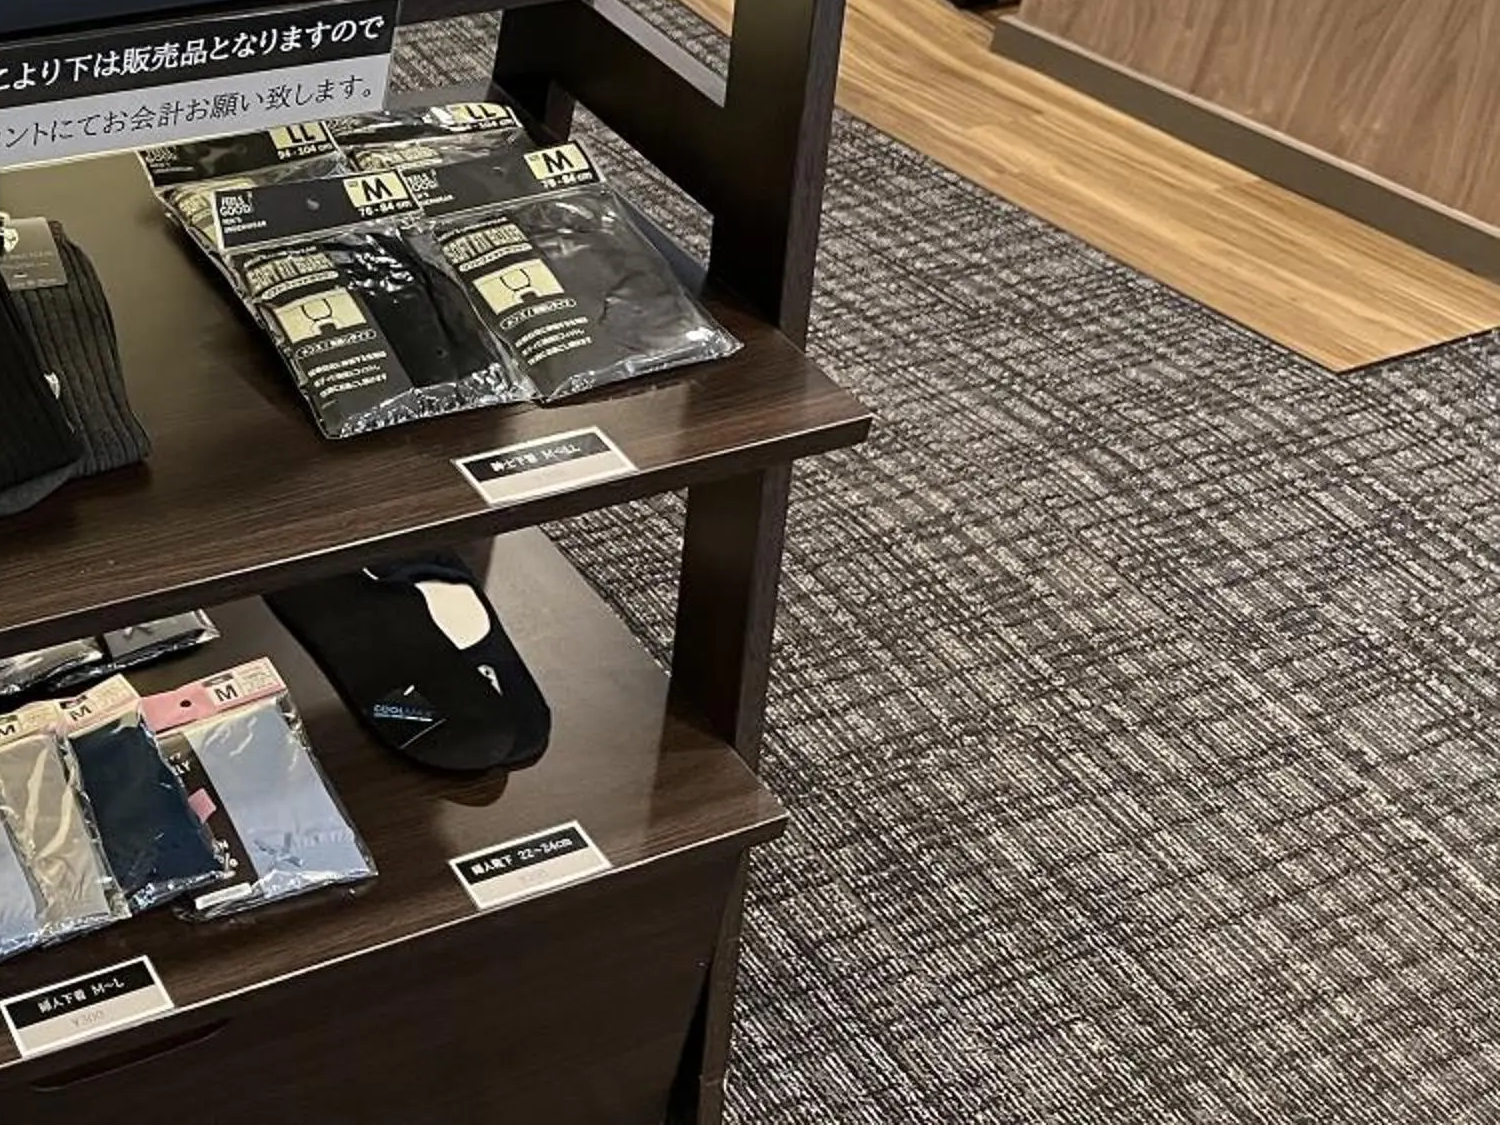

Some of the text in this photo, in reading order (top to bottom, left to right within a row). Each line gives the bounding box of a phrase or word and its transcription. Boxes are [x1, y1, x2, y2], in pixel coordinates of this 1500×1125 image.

[466, 104, 499, 119] LL
[286, 123, 317, 142] LL
[542, 149, 574, 174] M
[362, 177, 393, 202] M
[213, 684, 240, 703] M
[69, 707, 92, 722] M
[37, 988, 87, 1013] 婦人下着
